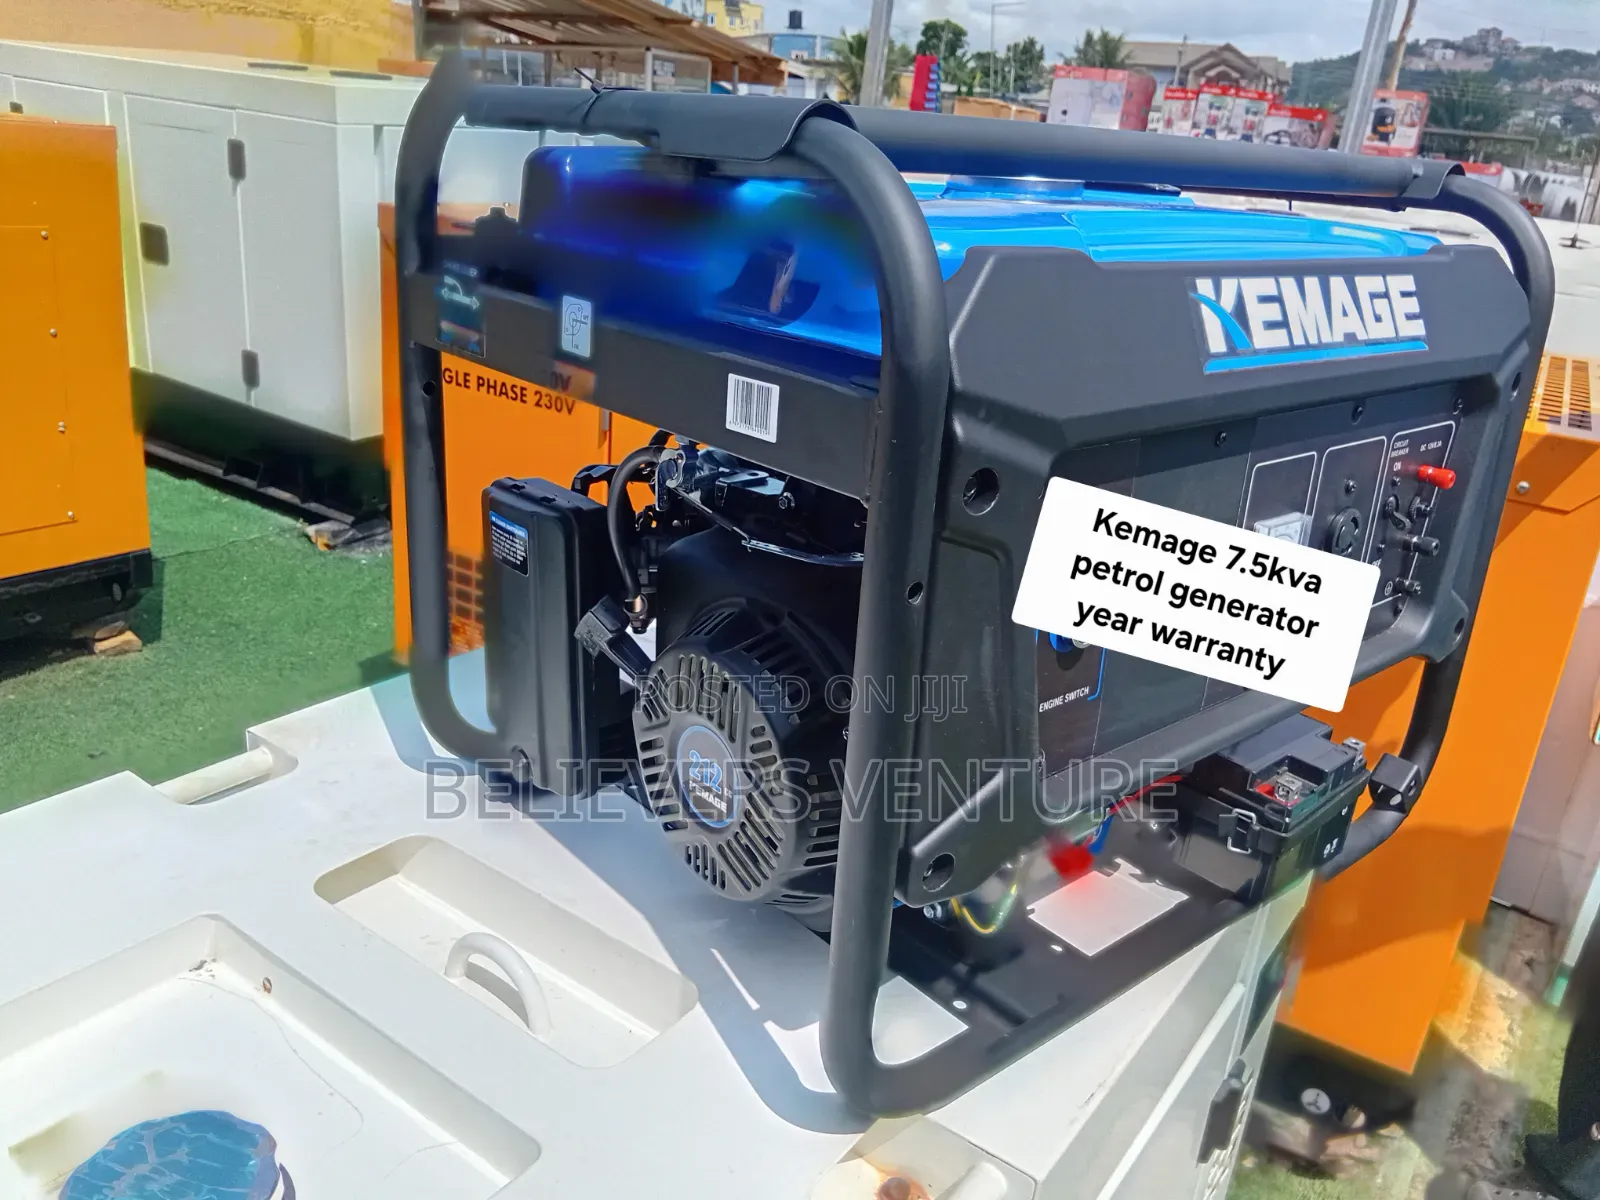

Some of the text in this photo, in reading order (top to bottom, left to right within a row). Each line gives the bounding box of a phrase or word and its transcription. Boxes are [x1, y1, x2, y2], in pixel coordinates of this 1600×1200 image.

[1190, 274, 1427, 354] KEMAGE
[476, 376, 528, 404] PHASE
[534, 390, 576, 416] 230V
[1393, 462, 1402, 471] ON
[1038, 685, 1090, 713] ENGINE SWITCH
[688, 749, 723, 795] 212
